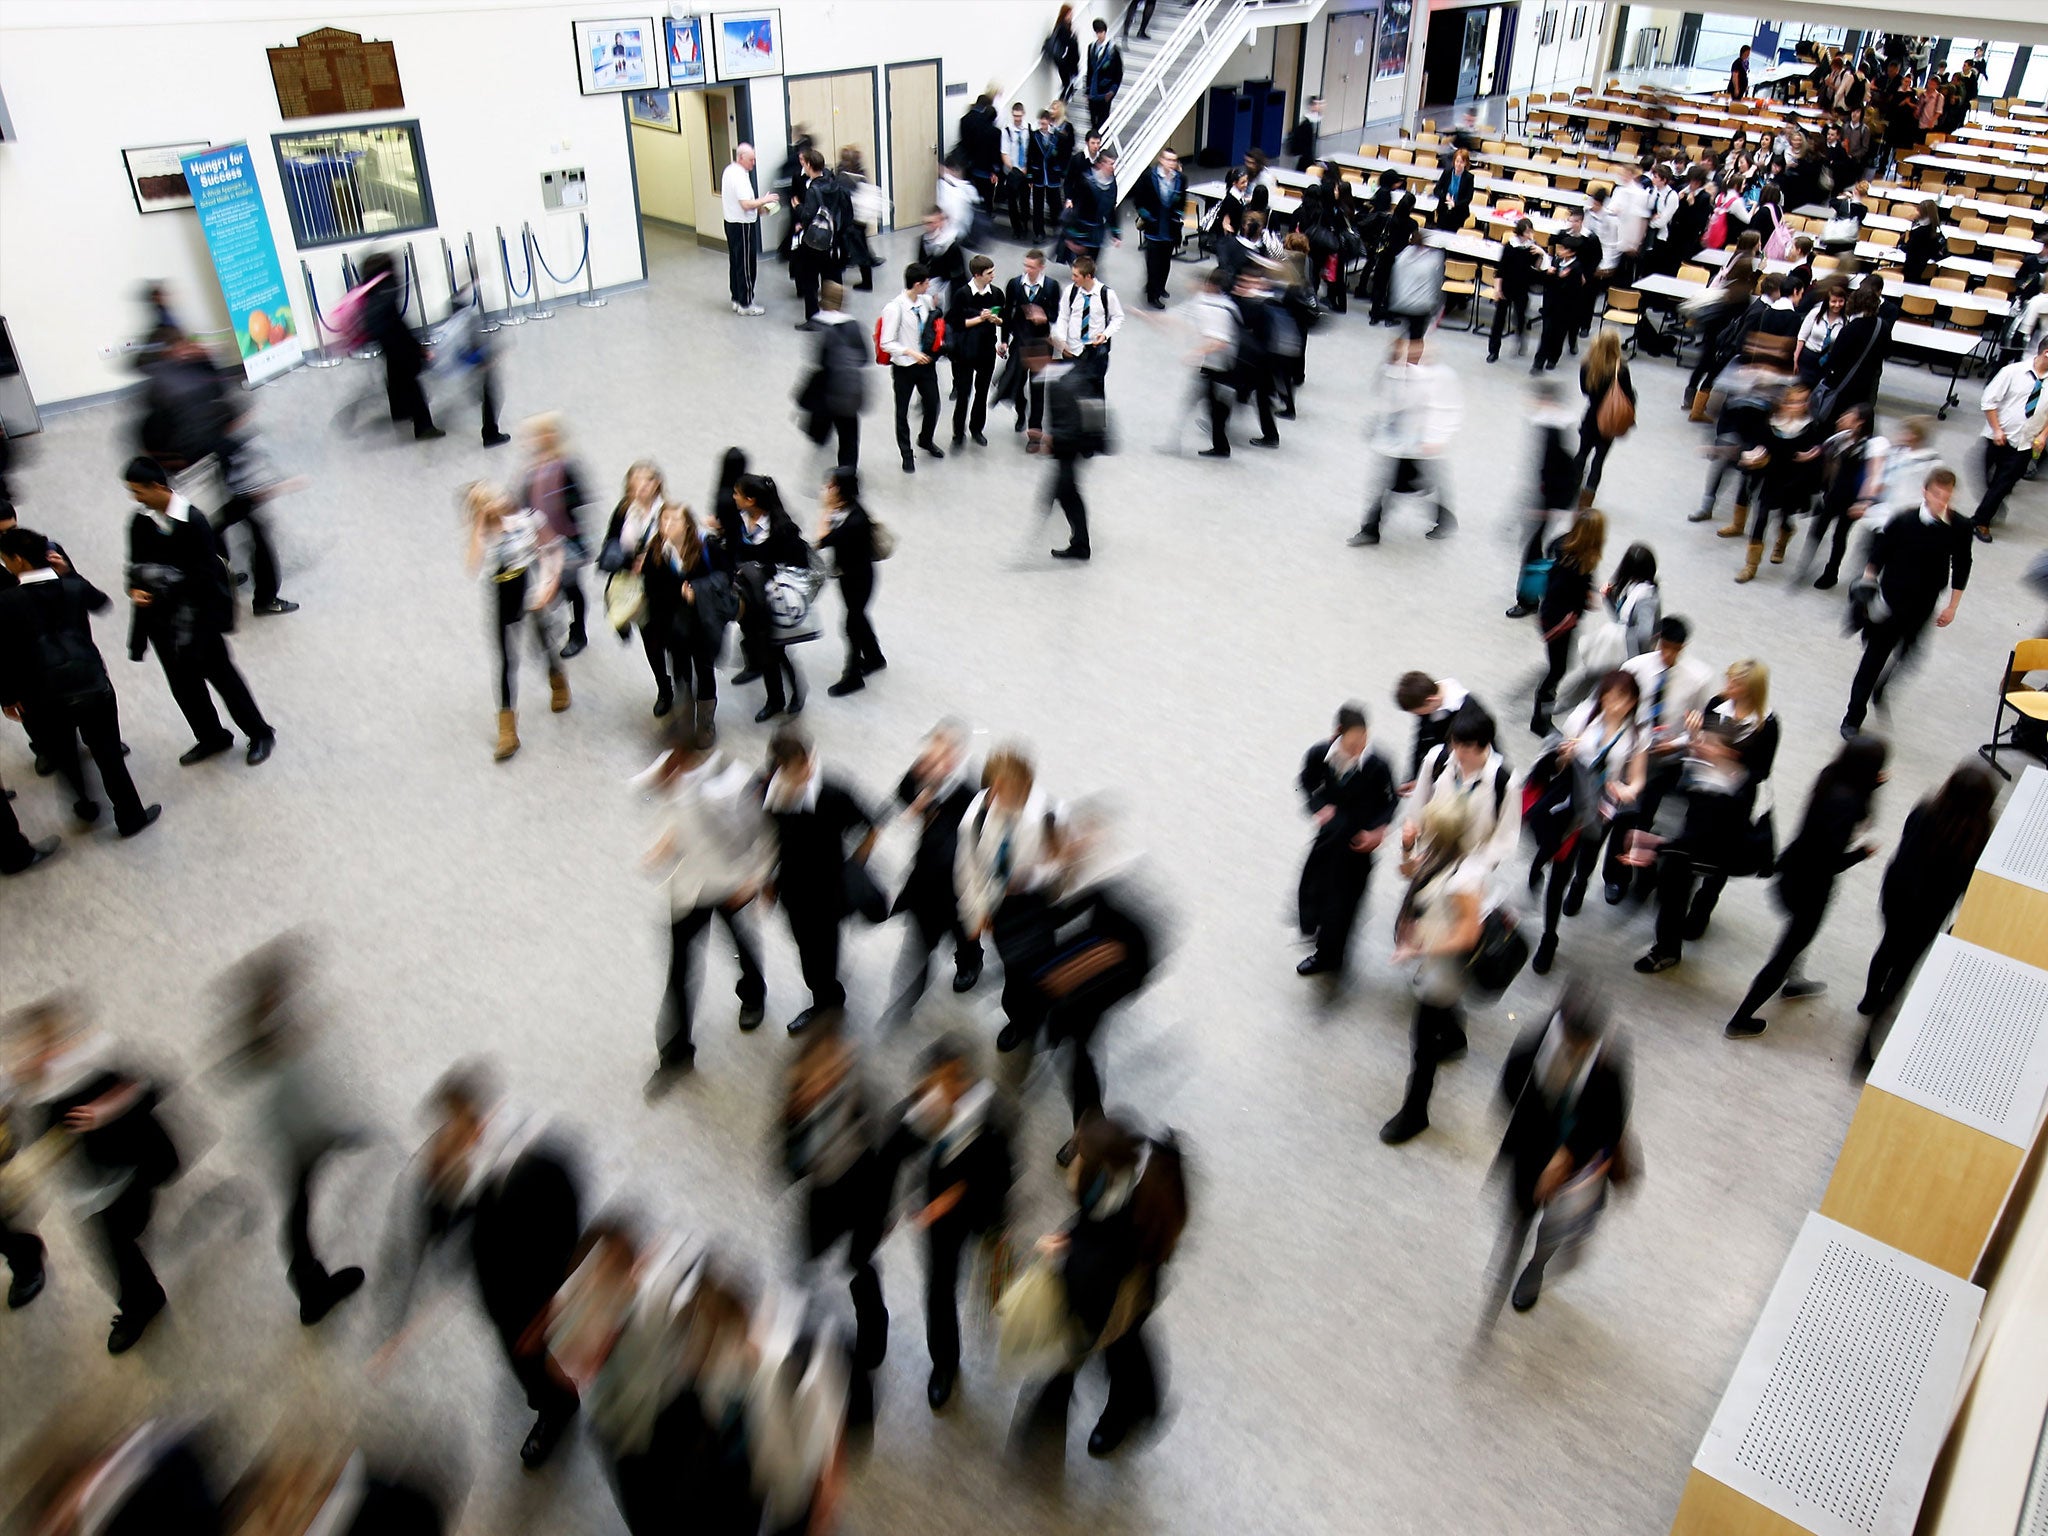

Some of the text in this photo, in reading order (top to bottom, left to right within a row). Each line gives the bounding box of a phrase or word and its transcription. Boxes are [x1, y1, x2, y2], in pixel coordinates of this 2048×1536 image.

[301, 29, 358, 43] WILLIAMWOOD
[327, 42, 354, 50] SCHOOL
[190, 156, 228, 176] Hungry
[230, 152, 243, 166] for
[200, 167, 243, 188] Success
[200, 198, 216, 208] School
